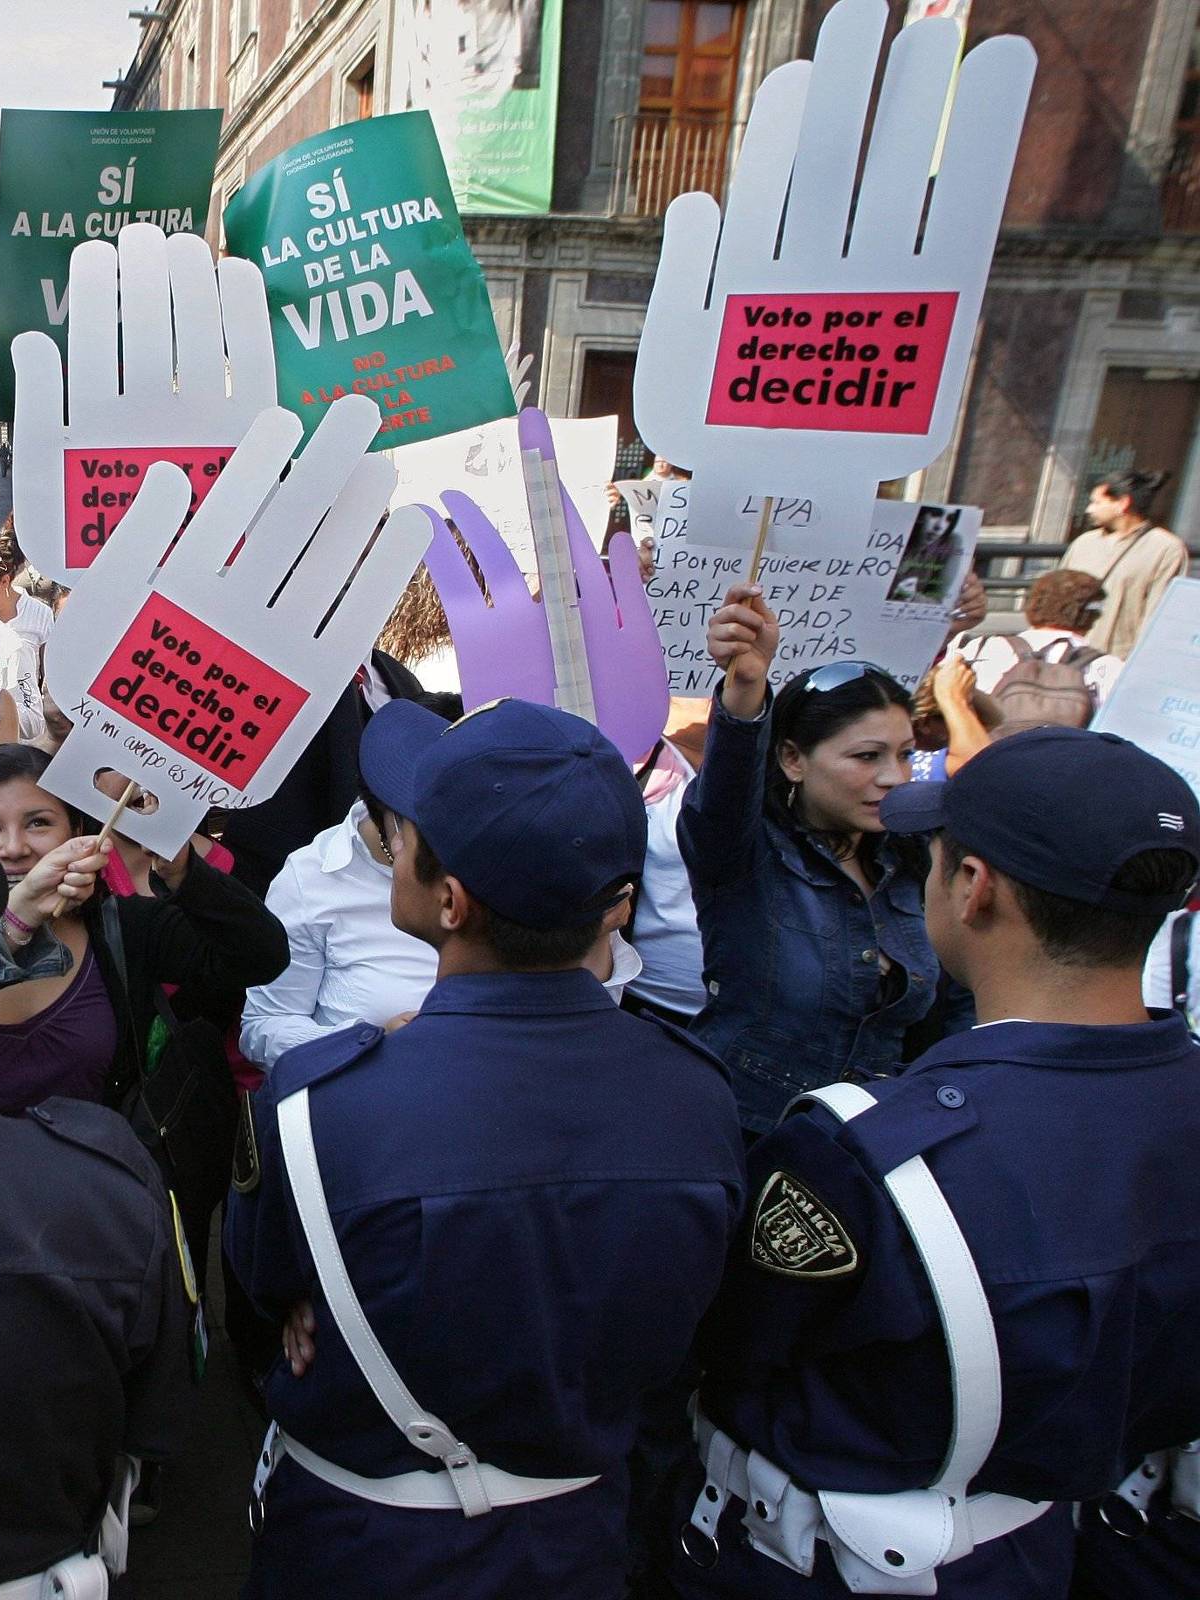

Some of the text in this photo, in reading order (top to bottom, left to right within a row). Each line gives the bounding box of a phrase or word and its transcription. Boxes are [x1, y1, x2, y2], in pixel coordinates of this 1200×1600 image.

[98, 157, 137, 206] SÍ
[306, 168, 351, 219] SÍ
[11, 211, 32, 237] A
[40, 212, 76, 238] LA
[262, 197, 443, 268] LA CULTURA
[304, 243, 391, 288] DE LA
[281, 269, 434, 350] VIDA
[744, 303, 929, 333] Voto por el
[352, 351, 386, 372] NO
[737, 336, 919, 363] derecho a
[302, 354, 456, 405] A LA CULTURA
[384, 390, 414, 409] LA
[728, 365, 916, 408] decidir
[379, 406, 431, 433] ERTE
[81, 460, 140, 478] Voto
[645, 577, 699, 599] GAR
[809, 584, 847, 602] DE
[150, 619, 281, 716] Voto por el
[131, 648, 261, 740] derecho a
[109, 674, 246, 770] decidir
[100, 720, 121, 739] mi
[123, 735, 167, 768] cuerpo
[168, 764, 186, 783] es
